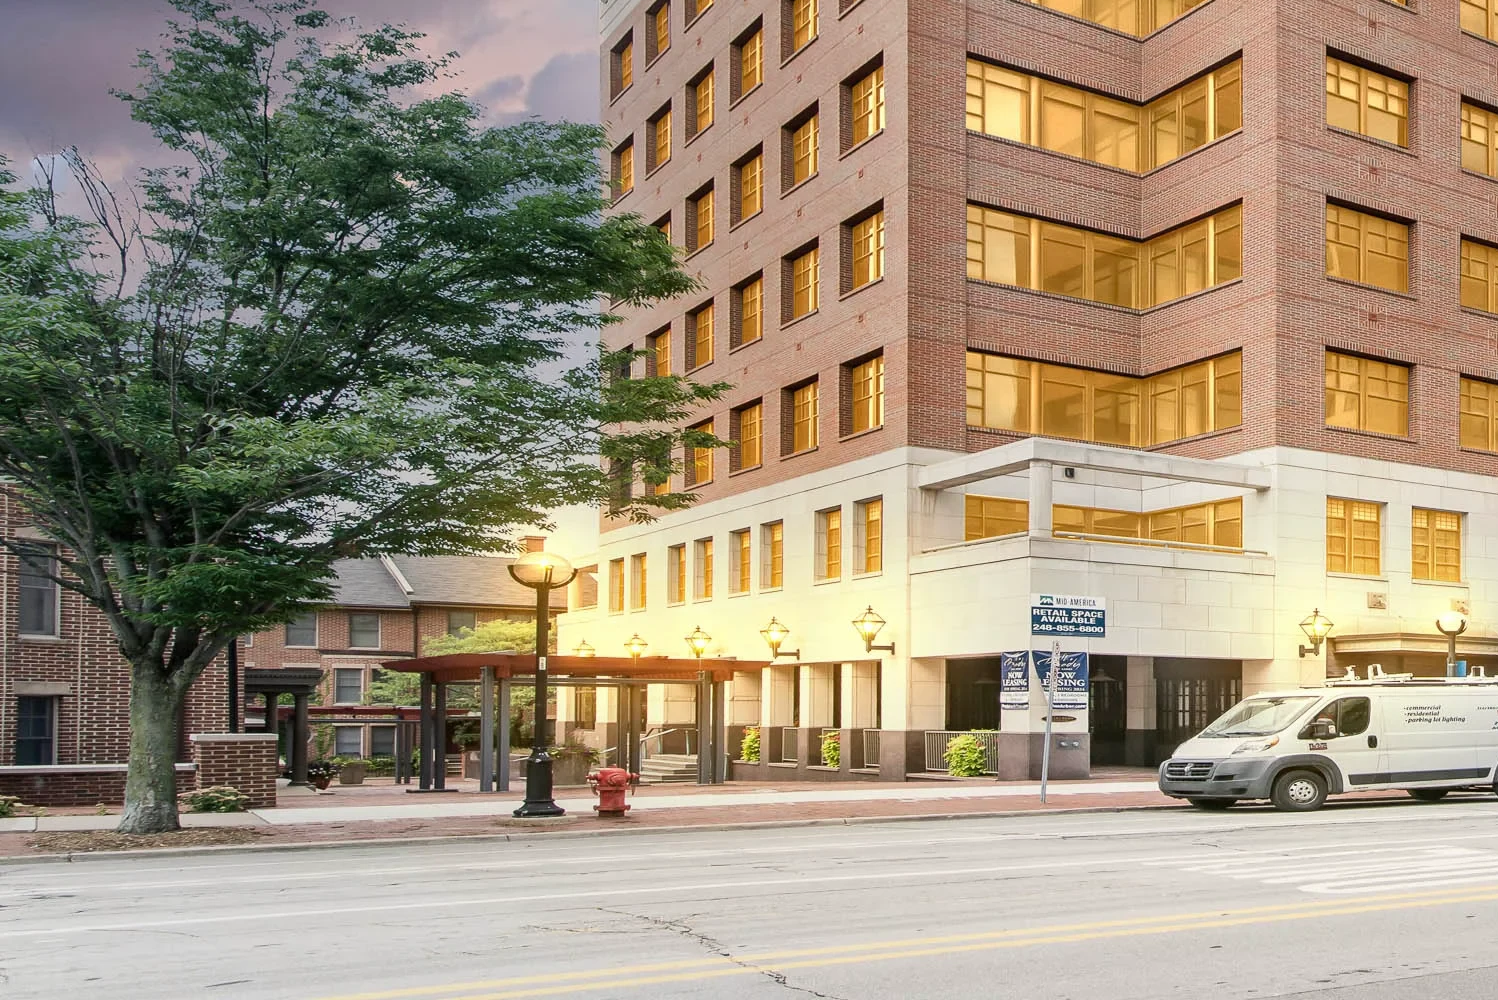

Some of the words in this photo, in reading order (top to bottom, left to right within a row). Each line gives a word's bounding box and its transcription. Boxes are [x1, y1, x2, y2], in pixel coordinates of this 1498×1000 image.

[1071, 610, 1103, 618] SPACE
[1041, 616, 1096, 624] AVAILABLE
[1033, 624, 1103, 632] 248-855-6800
[1003, 679, 1028, 687] LEASING
